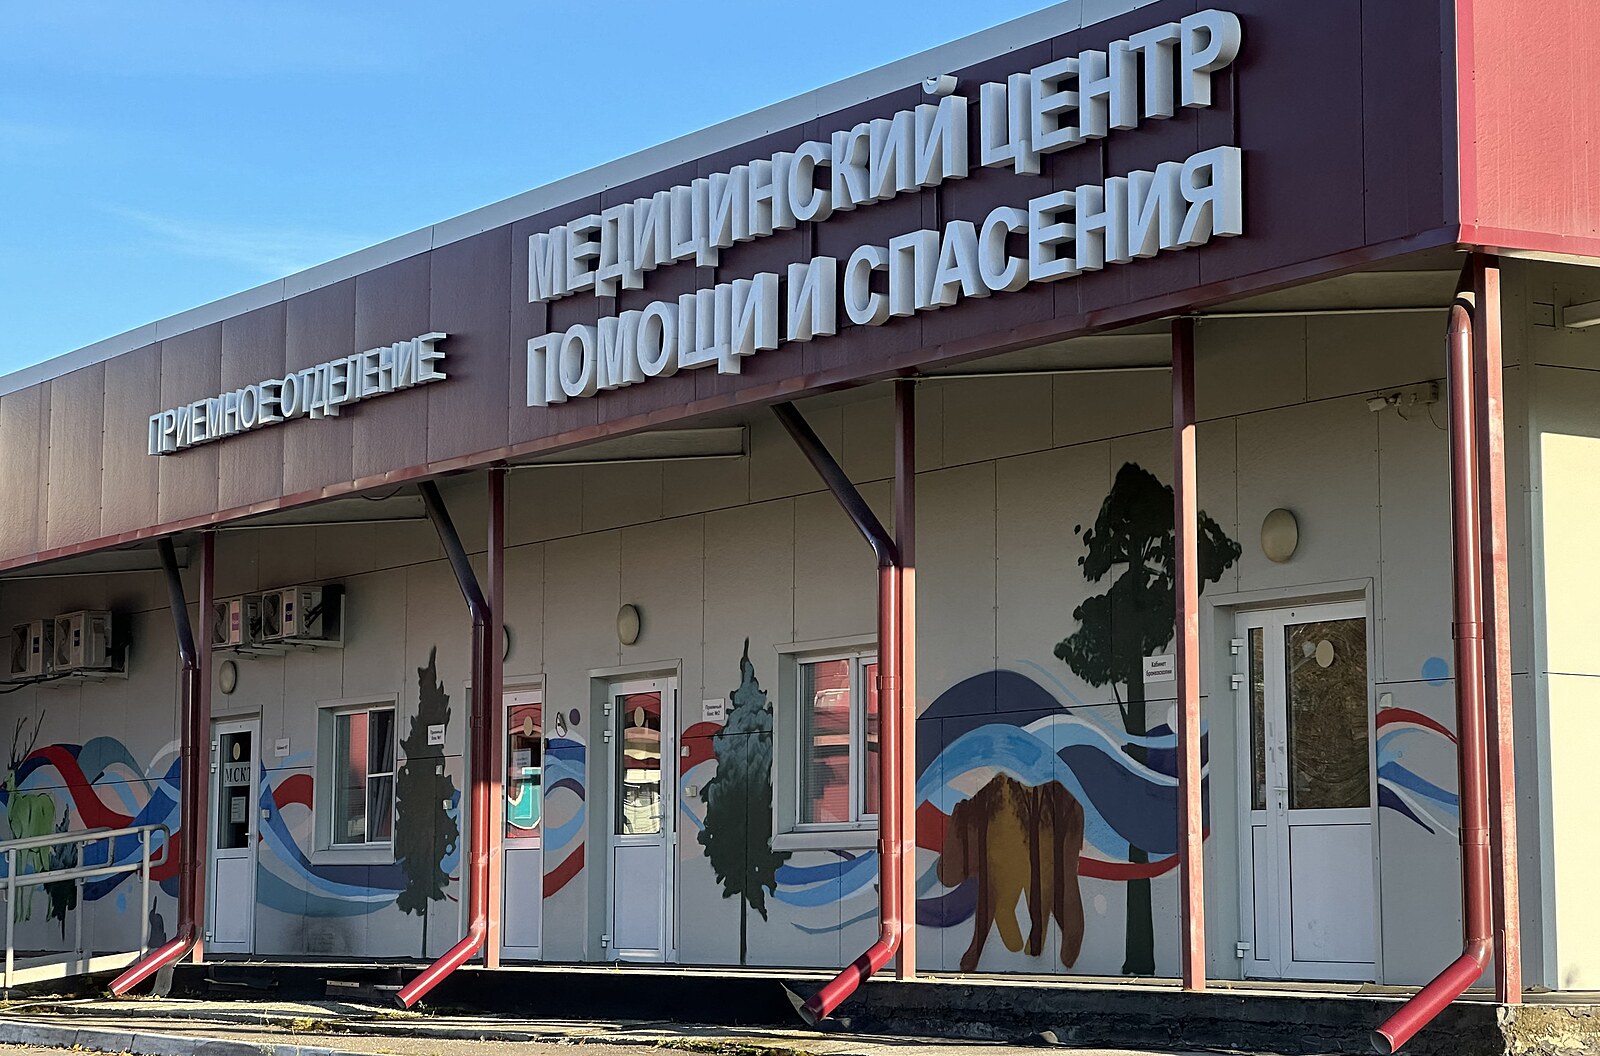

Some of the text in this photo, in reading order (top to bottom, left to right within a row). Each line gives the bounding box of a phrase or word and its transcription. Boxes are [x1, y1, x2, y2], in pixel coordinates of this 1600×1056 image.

[527, 146, 1243, 407] ПОМОЩИ И СПАСЕНИЯ
[528, 9, 1242, 303] МЕДИЦИНСКИЙ ЦЕНТР
[148, 332, 447, 456] ПРИЕМНОЕ ОТДЕЛЕНИЕ
